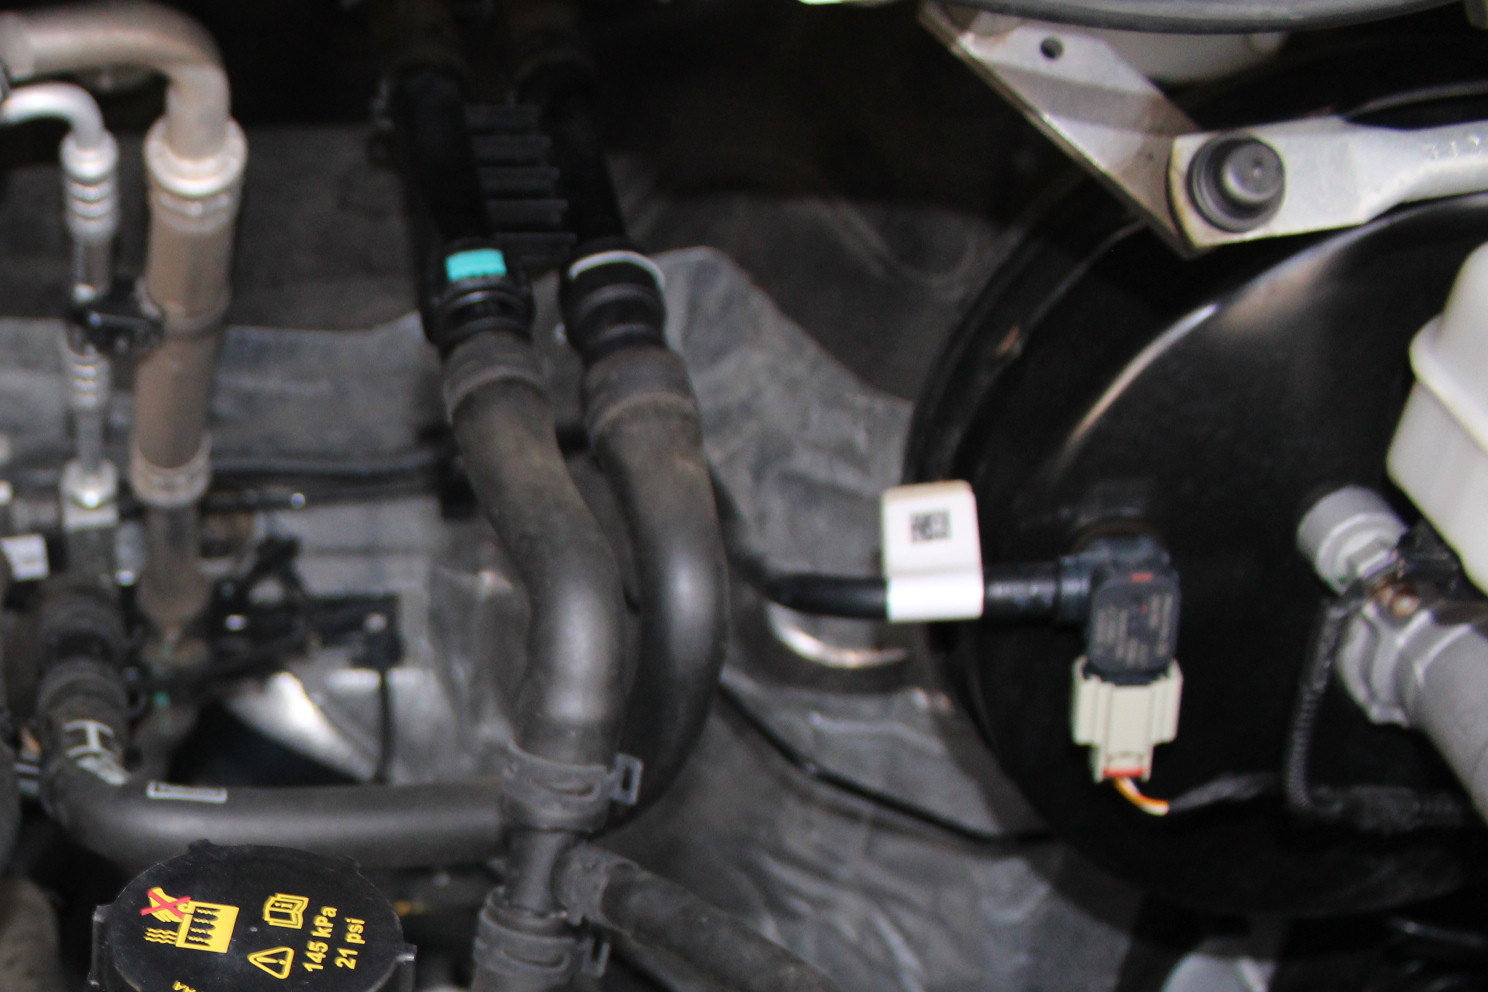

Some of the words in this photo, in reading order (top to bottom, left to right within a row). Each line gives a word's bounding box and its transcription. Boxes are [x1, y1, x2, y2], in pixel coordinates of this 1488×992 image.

[310, 905, 338, 938] kPa
[344, 917, 367, 945] psi
[302, 940, 329, 972] 145
[334, 948, 359, 970] 21
